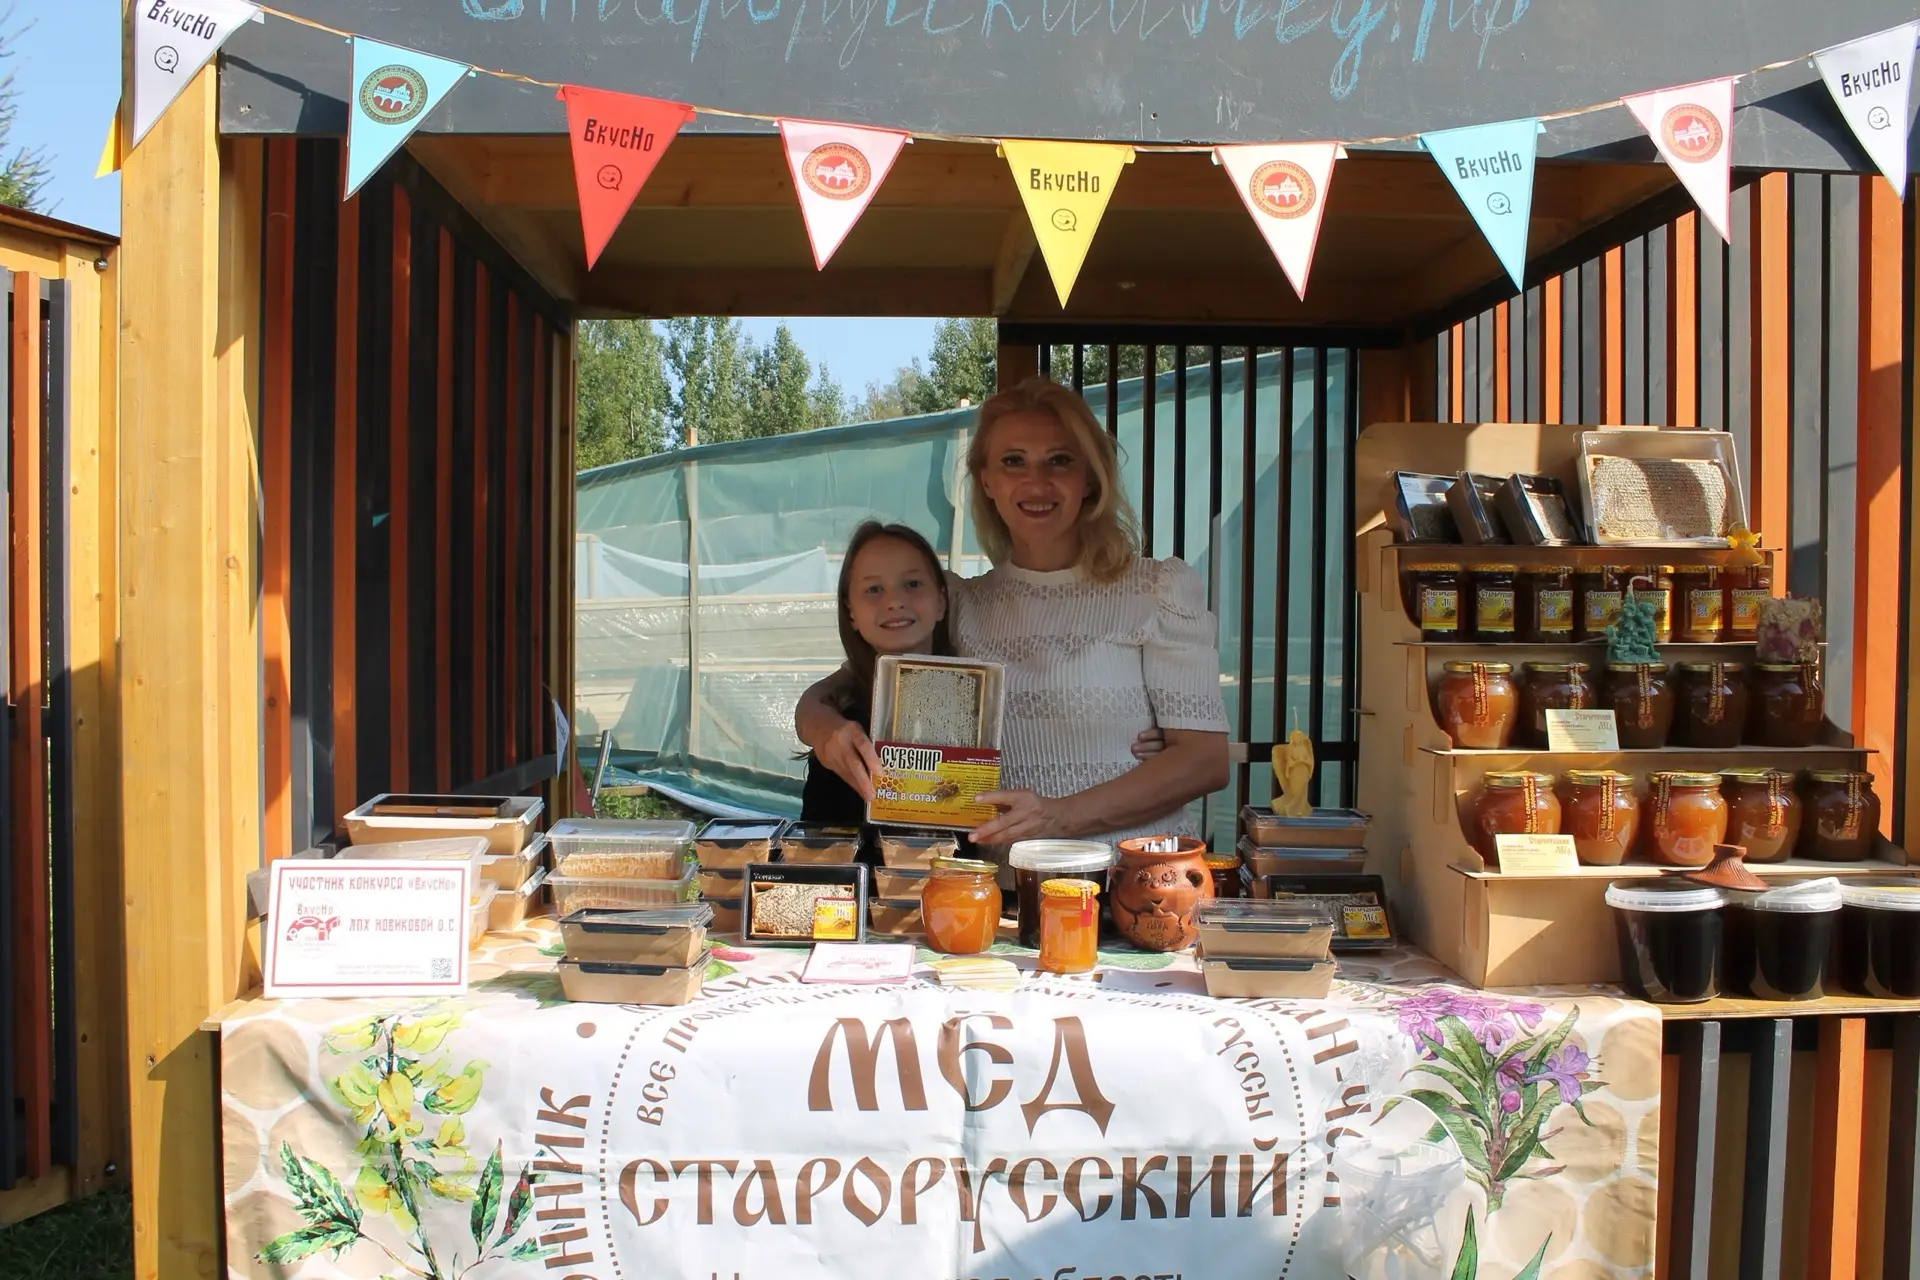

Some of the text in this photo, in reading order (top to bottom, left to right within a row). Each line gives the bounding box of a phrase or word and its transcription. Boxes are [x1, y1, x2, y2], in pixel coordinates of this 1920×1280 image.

[881, 746, 942, 772] СУВЕНИР
[909, 793, 938, 803] сотах
[289, 876, 344, 891] УЧАСТНИК
[349, 876, 403, 890] КОНКУРСА
[349, 918, 371, 931] ЛПХ
[636, 1060, 676, 1126] ВСЕ
[1212, 1016, 1275, 1122] РУССЫ
[532, 1086, 598, 1280] ННИК
[618, 1136, 1288, 1253] СТАРОРУССКИЙ
